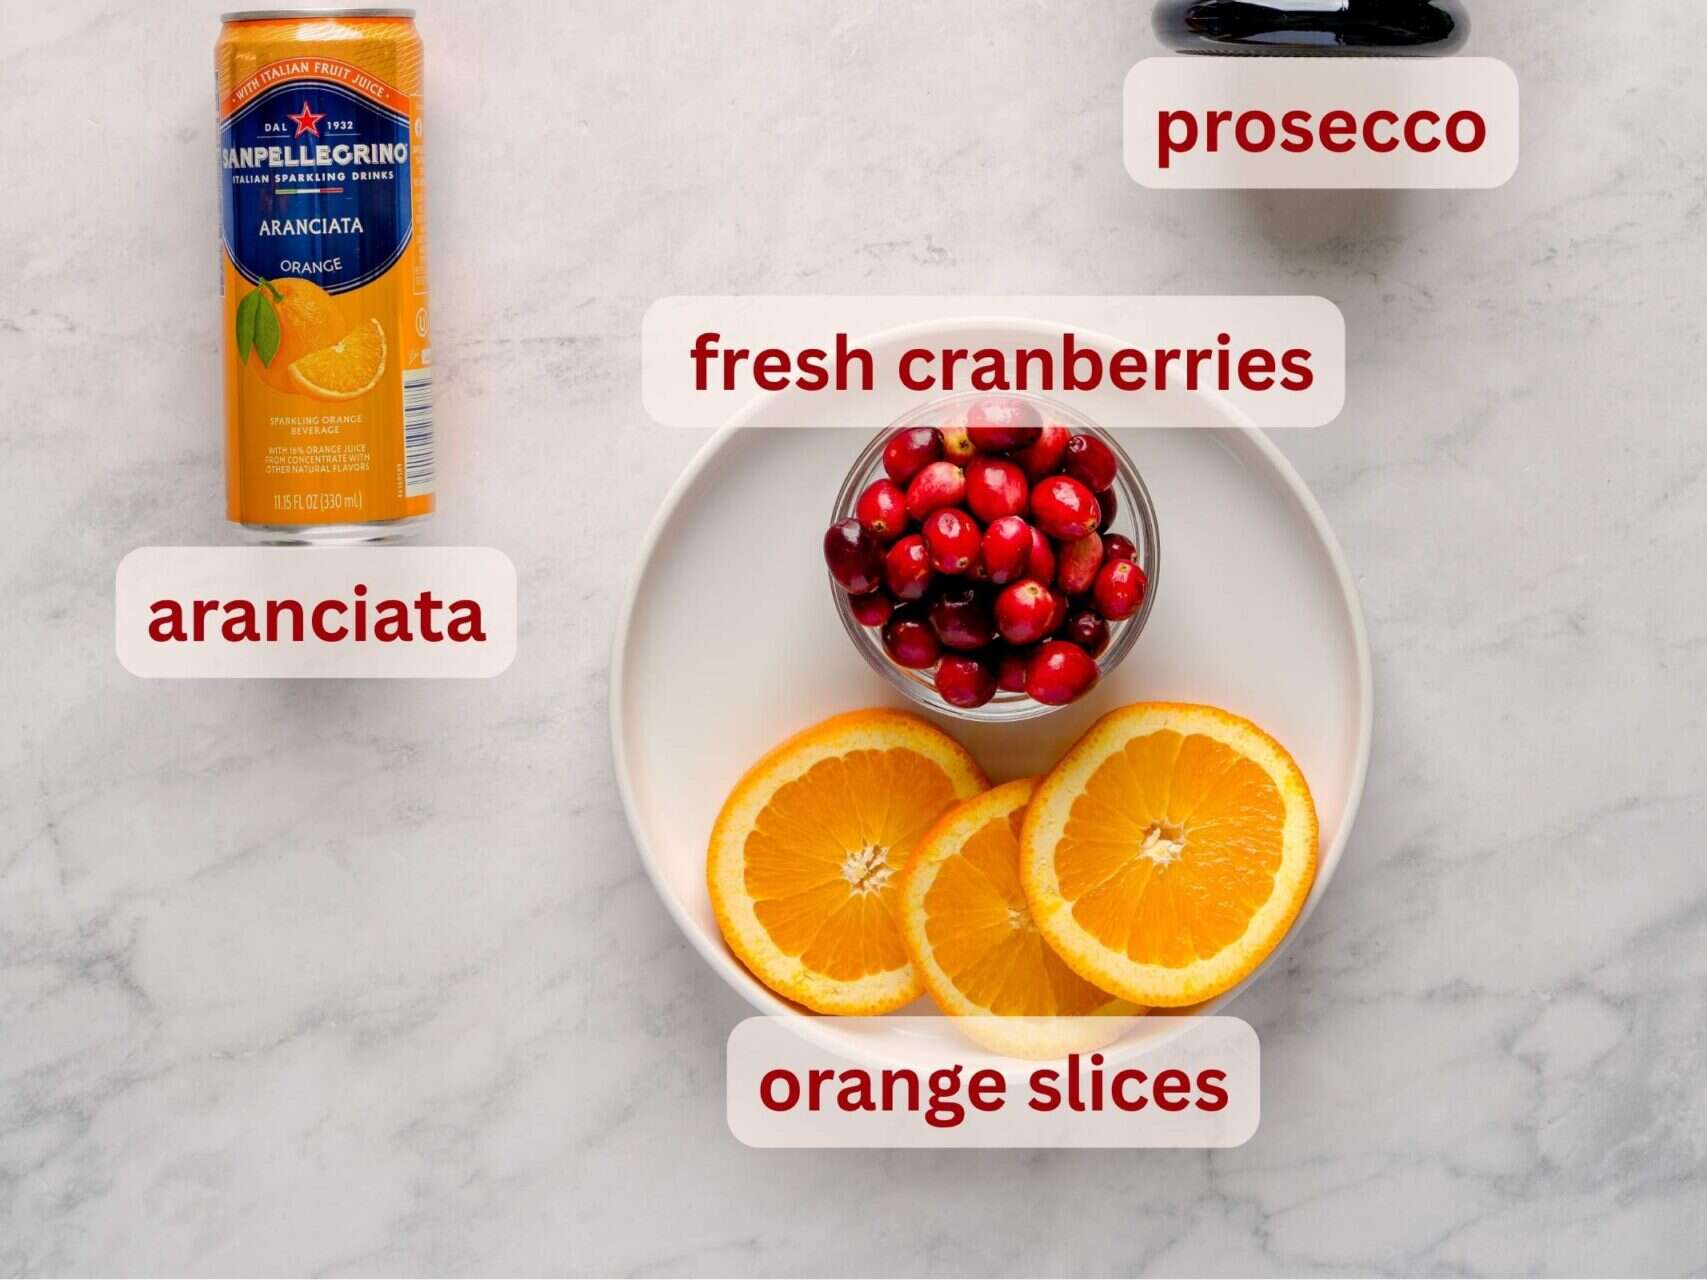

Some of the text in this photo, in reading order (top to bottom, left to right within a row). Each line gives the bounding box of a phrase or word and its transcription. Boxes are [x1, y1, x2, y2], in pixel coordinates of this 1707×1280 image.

[236, 62, 385, 101] WITH ITALIAN FRUIT JUICE
[264, 121, 353, 133] DAL 1932
[222, 143, 408, 169] SANPELLEGRINO
[233, 171, 395, 184] ITALIAN SPARKLING DRINKS
[259, 217, 364, 236] ARANCIATA
[280, 257, 343, 274] ORANGE
[270, 414, 362, 425] SPARKLING ORANGE
[290, 426, 340, 435] BEVERAGE
[306, 444, 341, 455] ORANGE
[344, 443, 367, 453] JUICE
[265, 455, 286, 464] FROM
[287, 454, 347, 464] CONCENTRATE
[291, 464, 330, 473] NATURAL
[332, 463, 370, 472] FLAVORS
[293, 494, 304, 510] FL
[306, 493, 319, 509] OZ
[320, 491, 342, 511] (330
